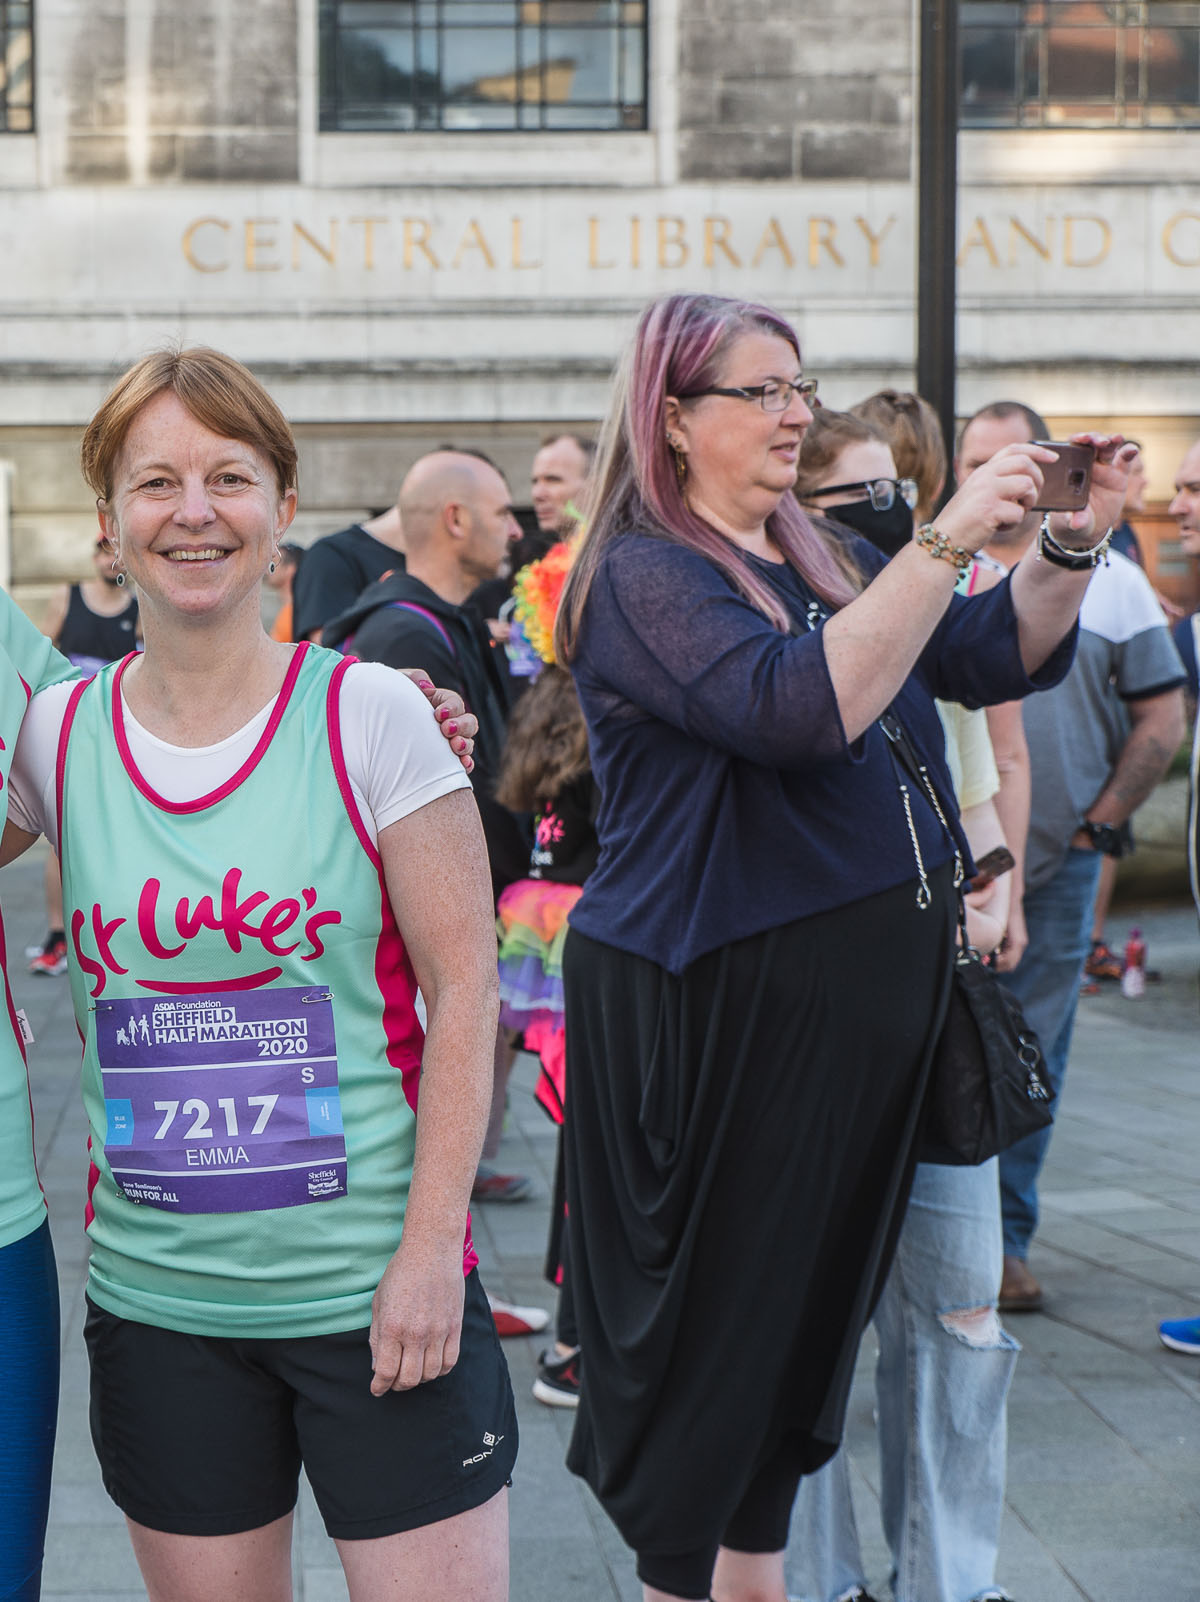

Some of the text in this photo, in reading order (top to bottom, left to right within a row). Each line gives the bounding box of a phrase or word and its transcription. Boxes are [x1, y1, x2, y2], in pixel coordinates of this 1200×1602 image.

[181, 215, 544, 273] CENTRAL
[588, 215, 897, 269] LIBRARY
[956, 215, 1113, 269] AND
[71, 867, 342, 998] St Luke's
[154, 1000, 221, 1012] ASDA Foundation
[154, 1008, 234, 1028] SHEFFIELD
[155, 1020, 305, 1044] HALF MARATHON
[257, 1037, 309, 1057] 2020
[301, 1066, 315, 1084] S
[153, 1094, 279, 1140] 7217
[186, 1146, 250, 1166] EMMA
[308, 1169, 337, 1180] Sheffield
[124, 1188, 180, 1203] RUN FOR ALL
